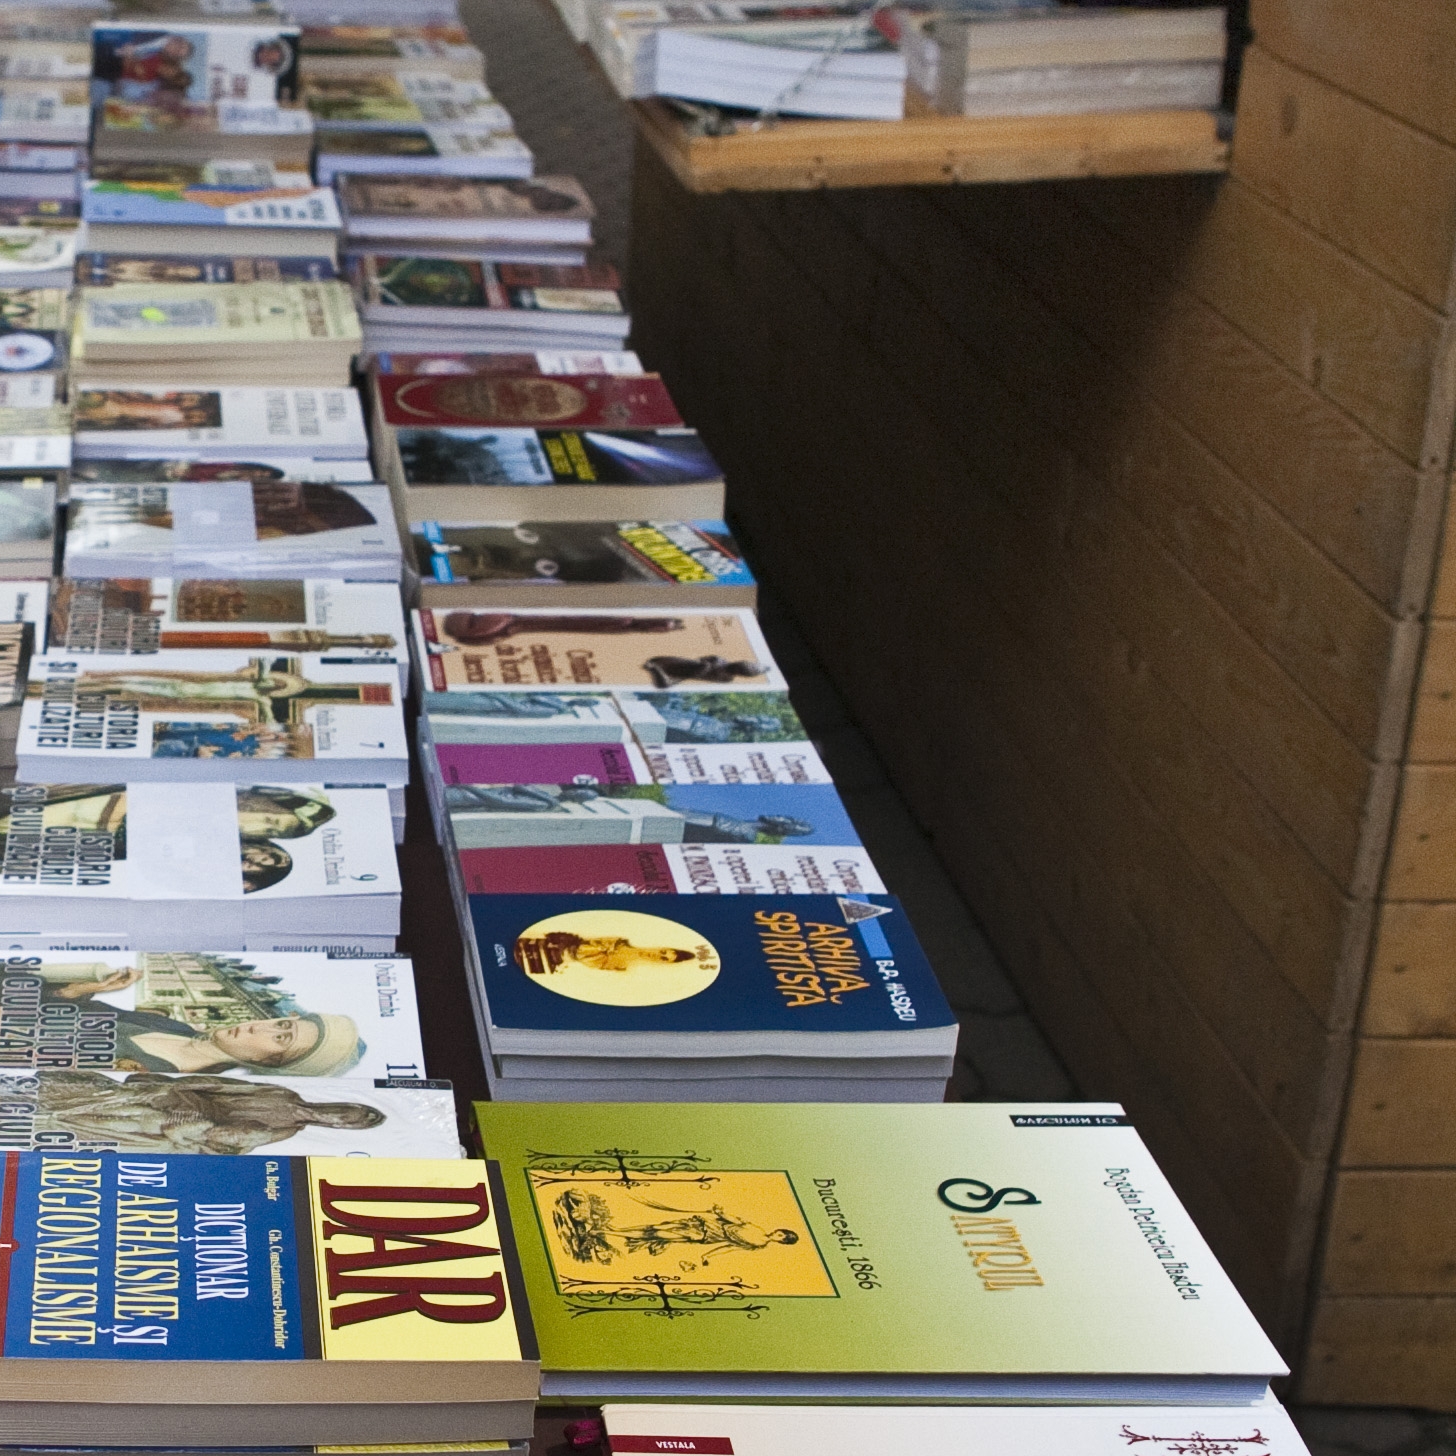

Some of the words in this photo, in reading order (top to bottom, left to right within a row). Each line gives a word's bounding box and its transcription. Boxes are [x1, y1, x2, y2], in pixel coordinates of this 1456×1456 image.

[41, 826, 79, 886] CULTURII
[76, 830, 114, 886] ISTORIA
[350, 873, 378, 882] 9
[375, 962, 397, 987] Ovidiu
[753, 910, 843, 1007] SPIRITISTĂ
[805, 921, 871, 994] ARHIVA
[377, 988, 399, 1017] Drimba
[887, 982, 918, 1022] HASDEU
[116, 1160, 168, 1190] DE
[265, 1160, 278, 1176] Gh.
[29, 1156, 103, 1347] REGIONALISME
[115, 1193, 181, 1322] ARHAISME
[179, 1202, 250, 1302] DICȚIONAR
[268, 1229, 281, 1245] Gh.
[318, 1178, 509, 1331] DAR
[810, 1177, 855, 1255] București,
[844, 1253, 879, 1292] 1866
[1103, 1167, 1144, 1205] Bogdan
[1128, 1206, 1176, 1260] Petriceicu
[1161, 1261, 1205, 1301] Hasdeu
[269, 1246, 287, 1350] Constantinescu-Dobridor
[97, 1322, 169, 1347] ȘI
[655, 1439, 697, 1450] VESTALA
